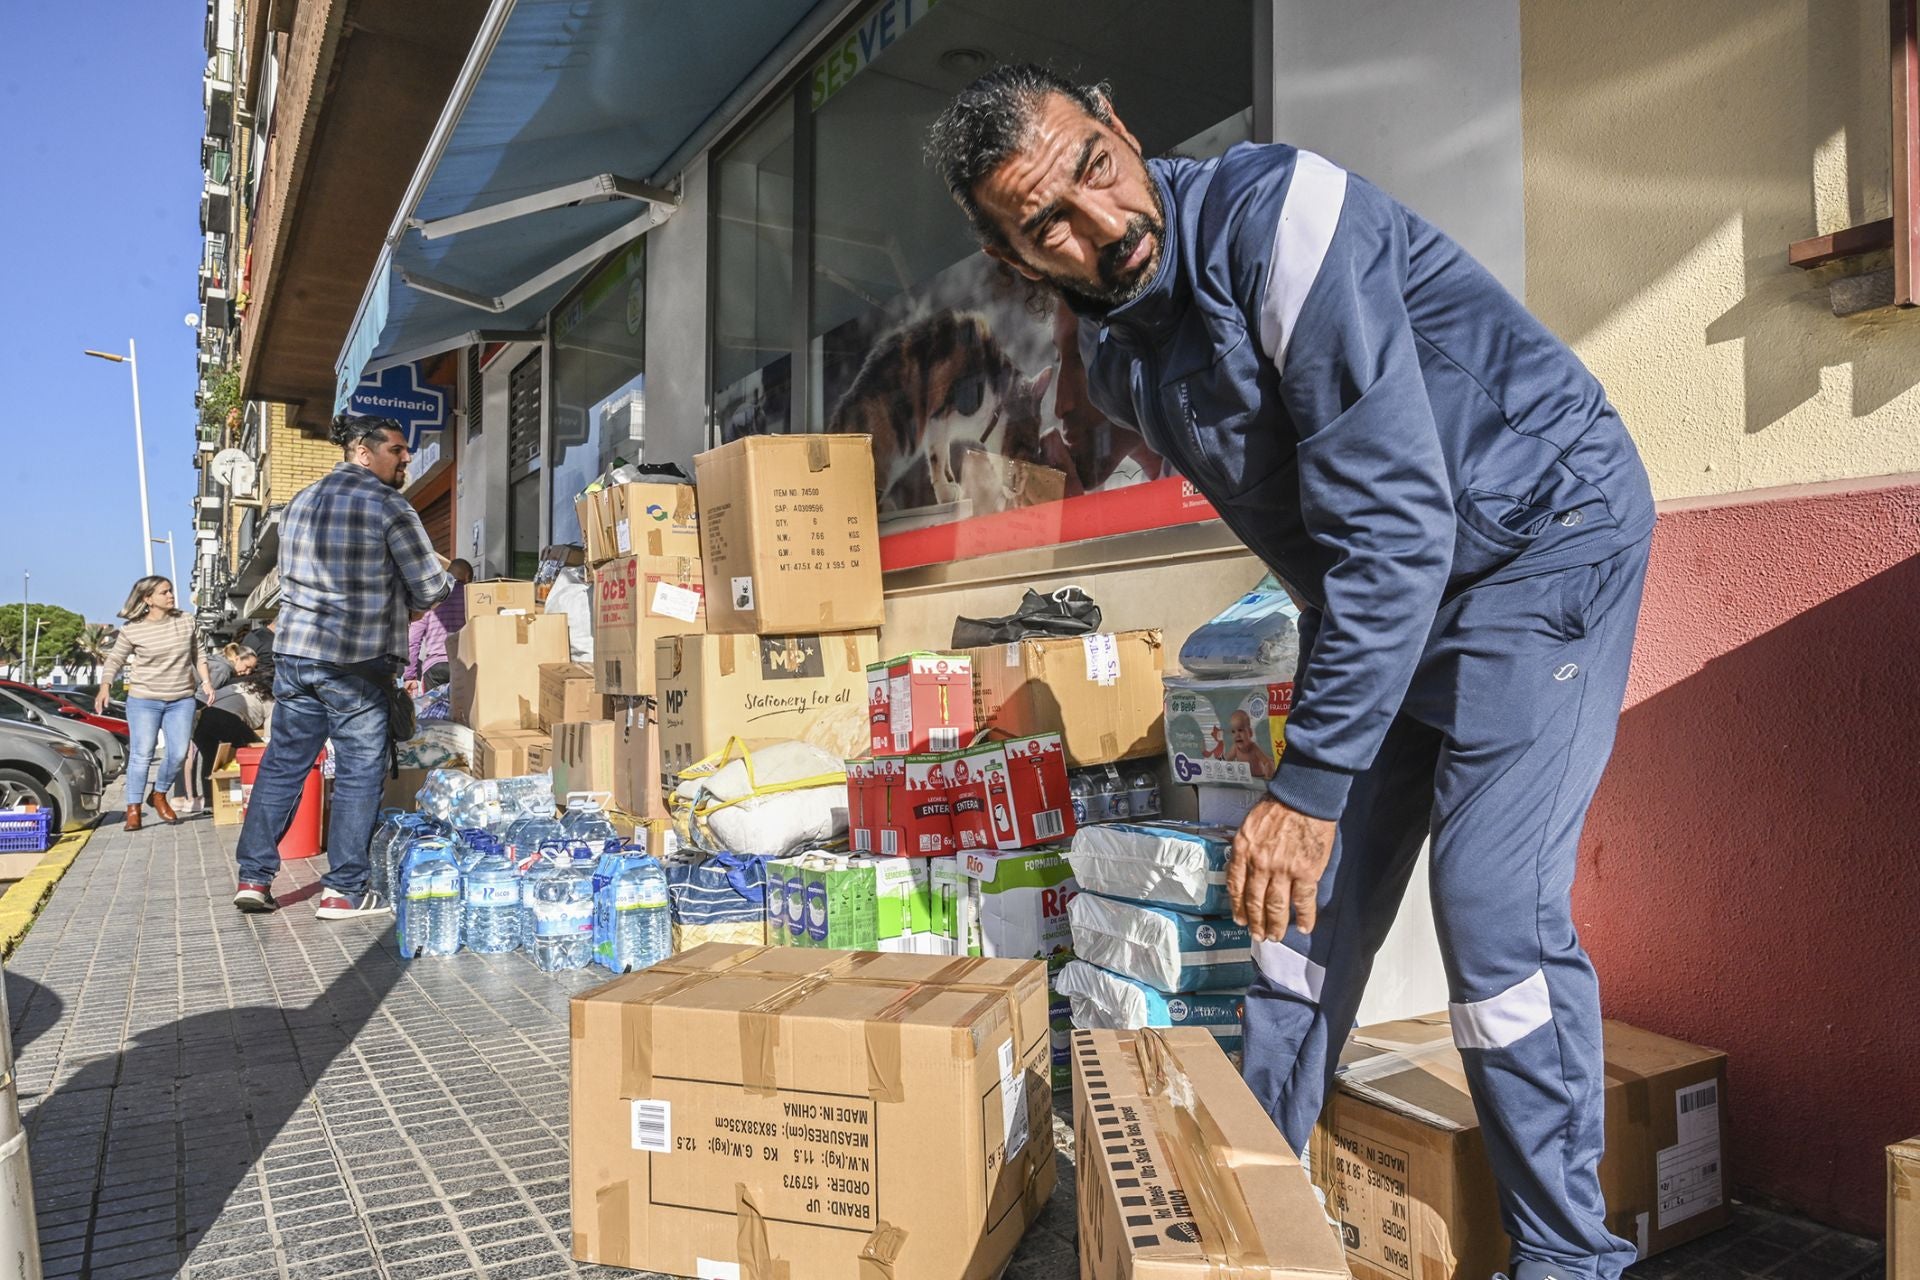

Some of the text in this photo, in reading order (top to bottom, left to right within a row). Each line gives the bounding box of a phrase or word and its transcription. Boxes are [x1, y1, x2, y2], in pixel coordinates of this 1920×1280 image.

[355, 395, 435, 412] veterinario
[773, 489, 788, 497] ITEM
[801, 488, 820, 496] 74500
[847, 516, 858, 524] PCS
[848, 531, 860, 539] KGS
[815, 562, 823, 570] 42
[603, 579, 626, 600] OCB
[744, 688, 851, 713] Stationery for all
[1270, 688, 1294, 702] 112
[1178, 760, 1189, 777] 3
[956, 800, 979, 812] ENTERA
[1024, 856, 1058, 871] FORMATO
[783, 1102, 868, 1124] MADE IN: CHINA
[715, 1116, 869, 1148] MEASURES(cm): 58X38X35cm
[1130, 1138, 1146, 1147] Car
[676, 1136, 870, 1172] N.W.(kg): 11.5 KG G.W.(kg): 12.5
[1134, 1148, 1152, 1163] Shark
[1366, 1146, 1376, 1162] IN
[1377, 1150, 1405, 1174] MADE
[1140, 1165, 1158, 1179] Ultra
[1336, 1157, 1345, 1173] 38
[1346, 1160, 1351, 1177] X
[782, 1174, 870, 1196] ORDER: 157973
[1367, 1168, 1405, 1198] MEASURES
[806, 1198, 870, 1219] BRAND: UP
[1154, 1208, 1173, 1220] Hot
[1381, 1217, 1407, 1242] ORDER
[1383, 1246, 1409, 1270] BRAND
